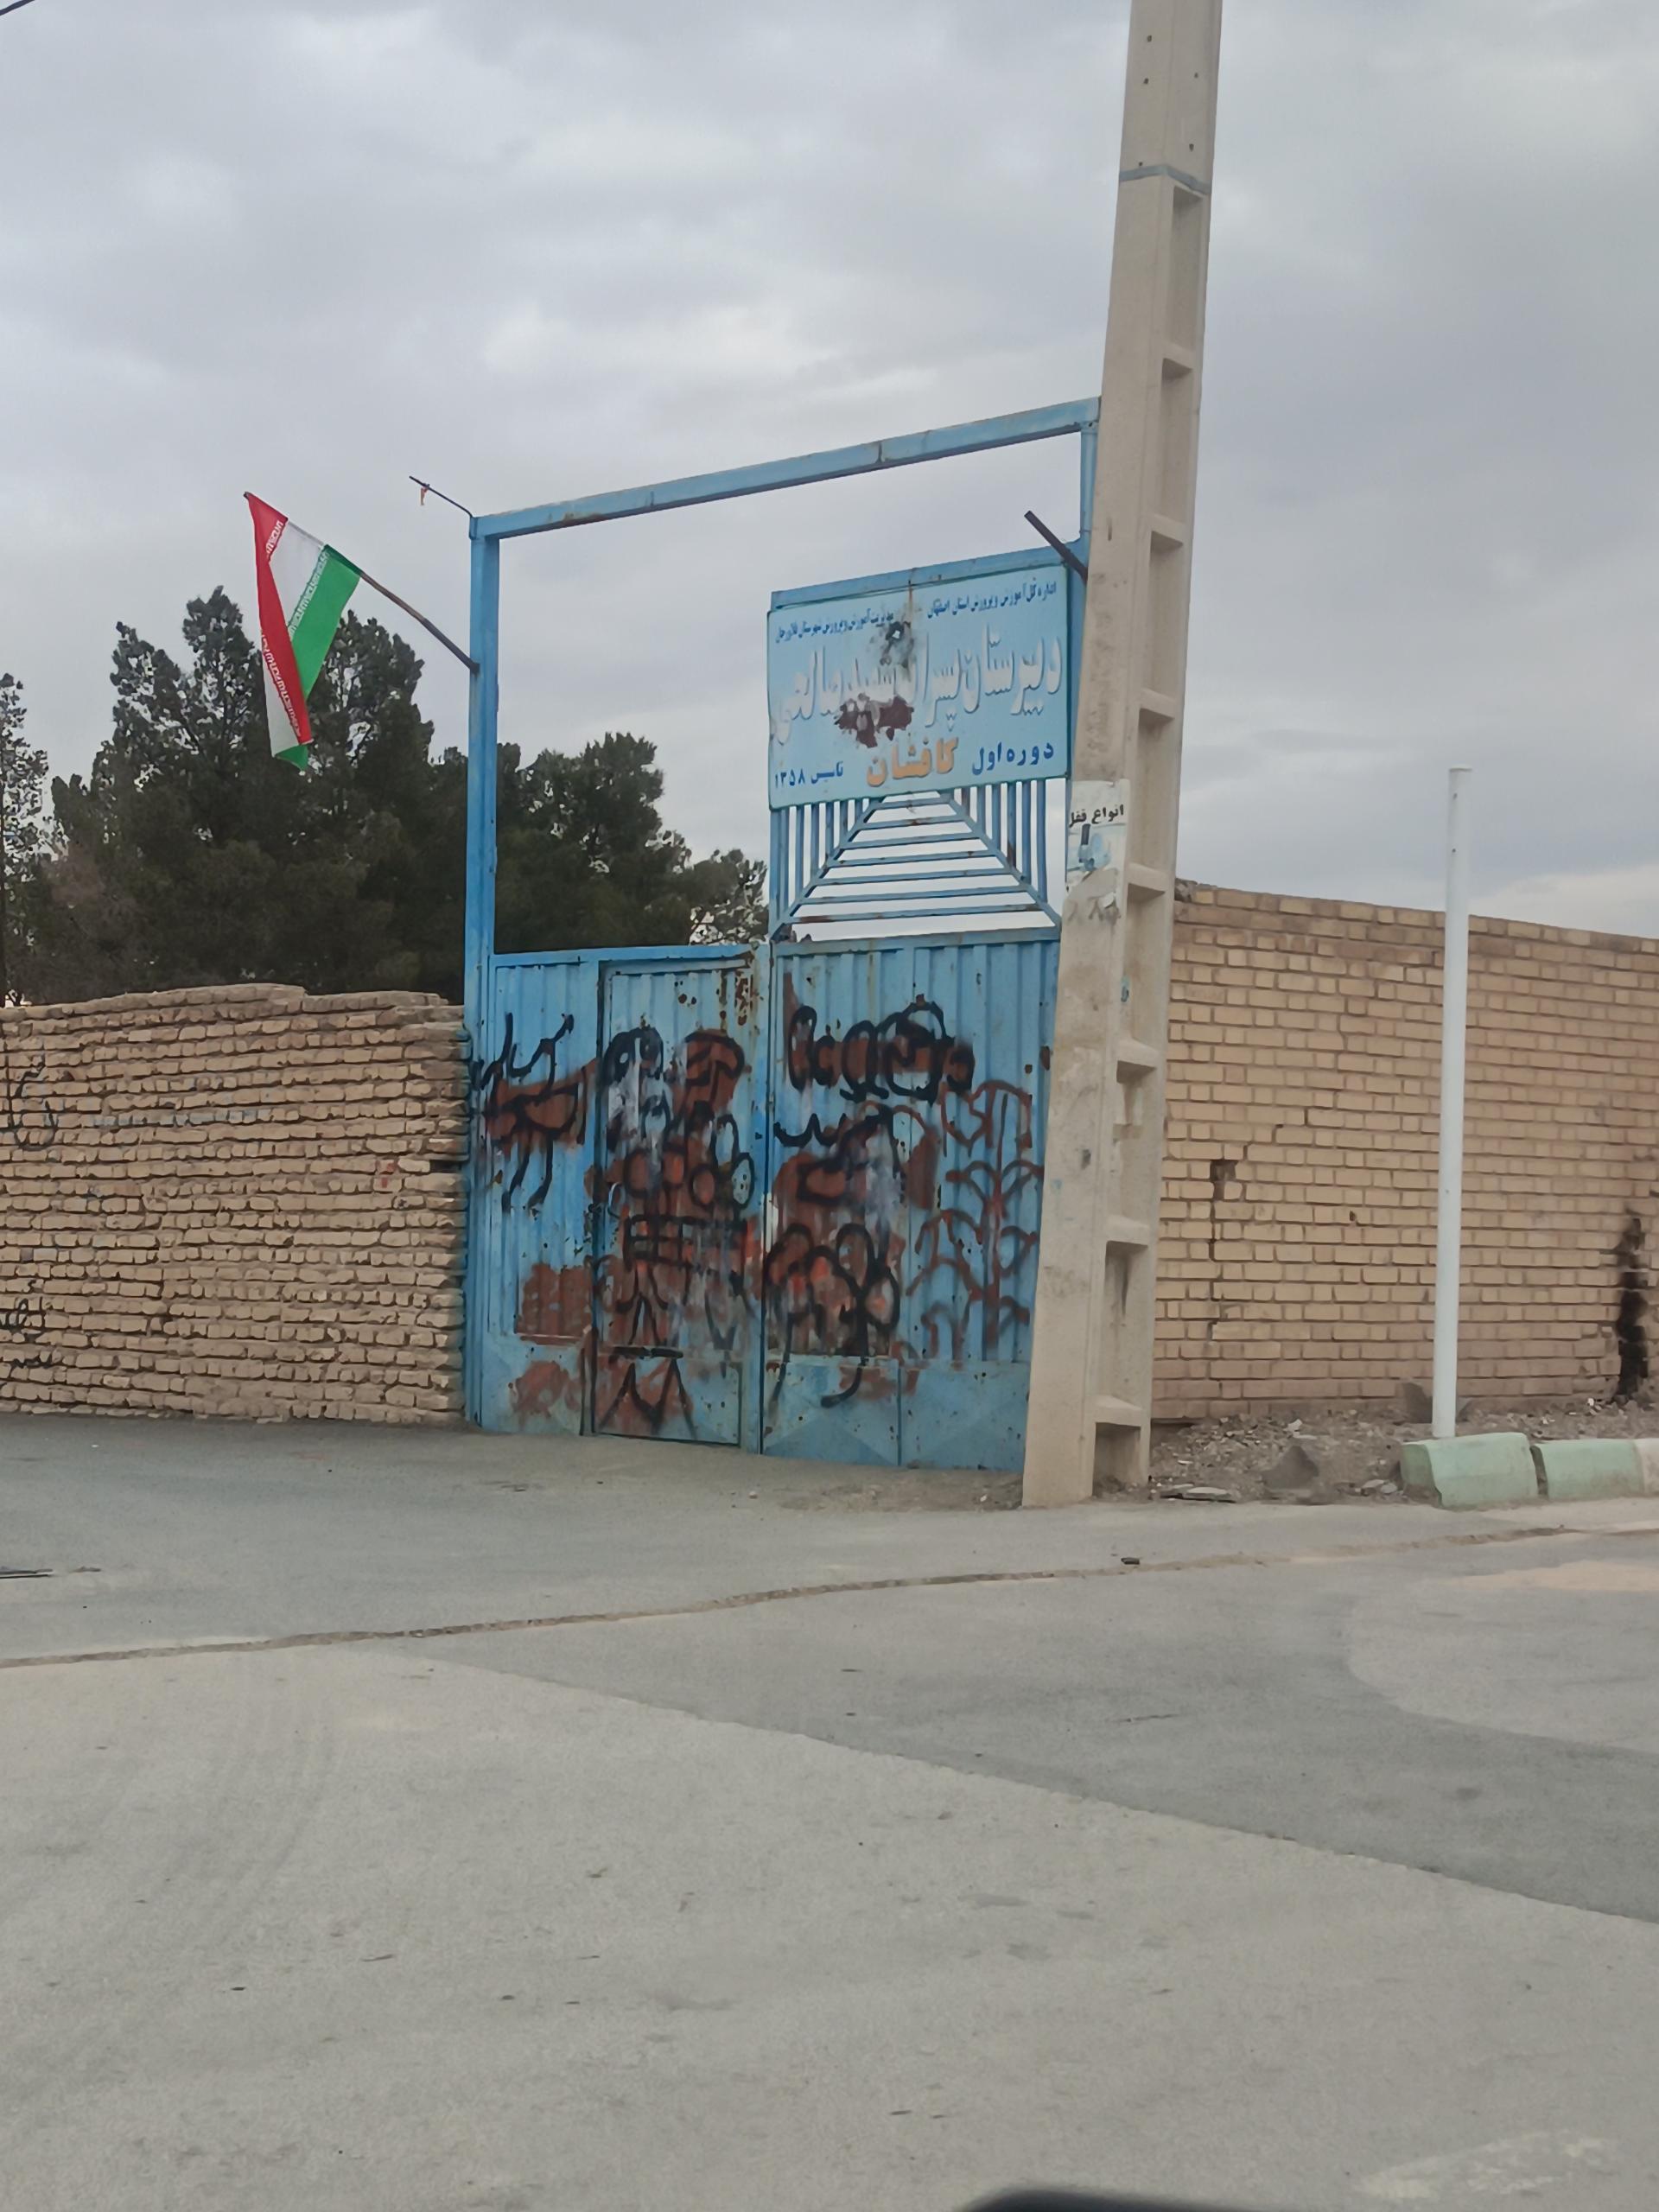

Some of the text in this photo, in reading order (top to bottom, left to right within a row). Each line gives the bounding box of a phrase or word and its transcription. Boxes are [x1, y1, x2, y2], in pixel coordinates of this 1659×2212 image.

[961, 622, 1064, 717] دبیرستان
[867, 736, 959, 788] کافشان
[971, 741, 1055, 776] دوره اول
[774, 768, 806, 789] ۱۳۵۸
[1090, 804, 1124, 824] انواع
